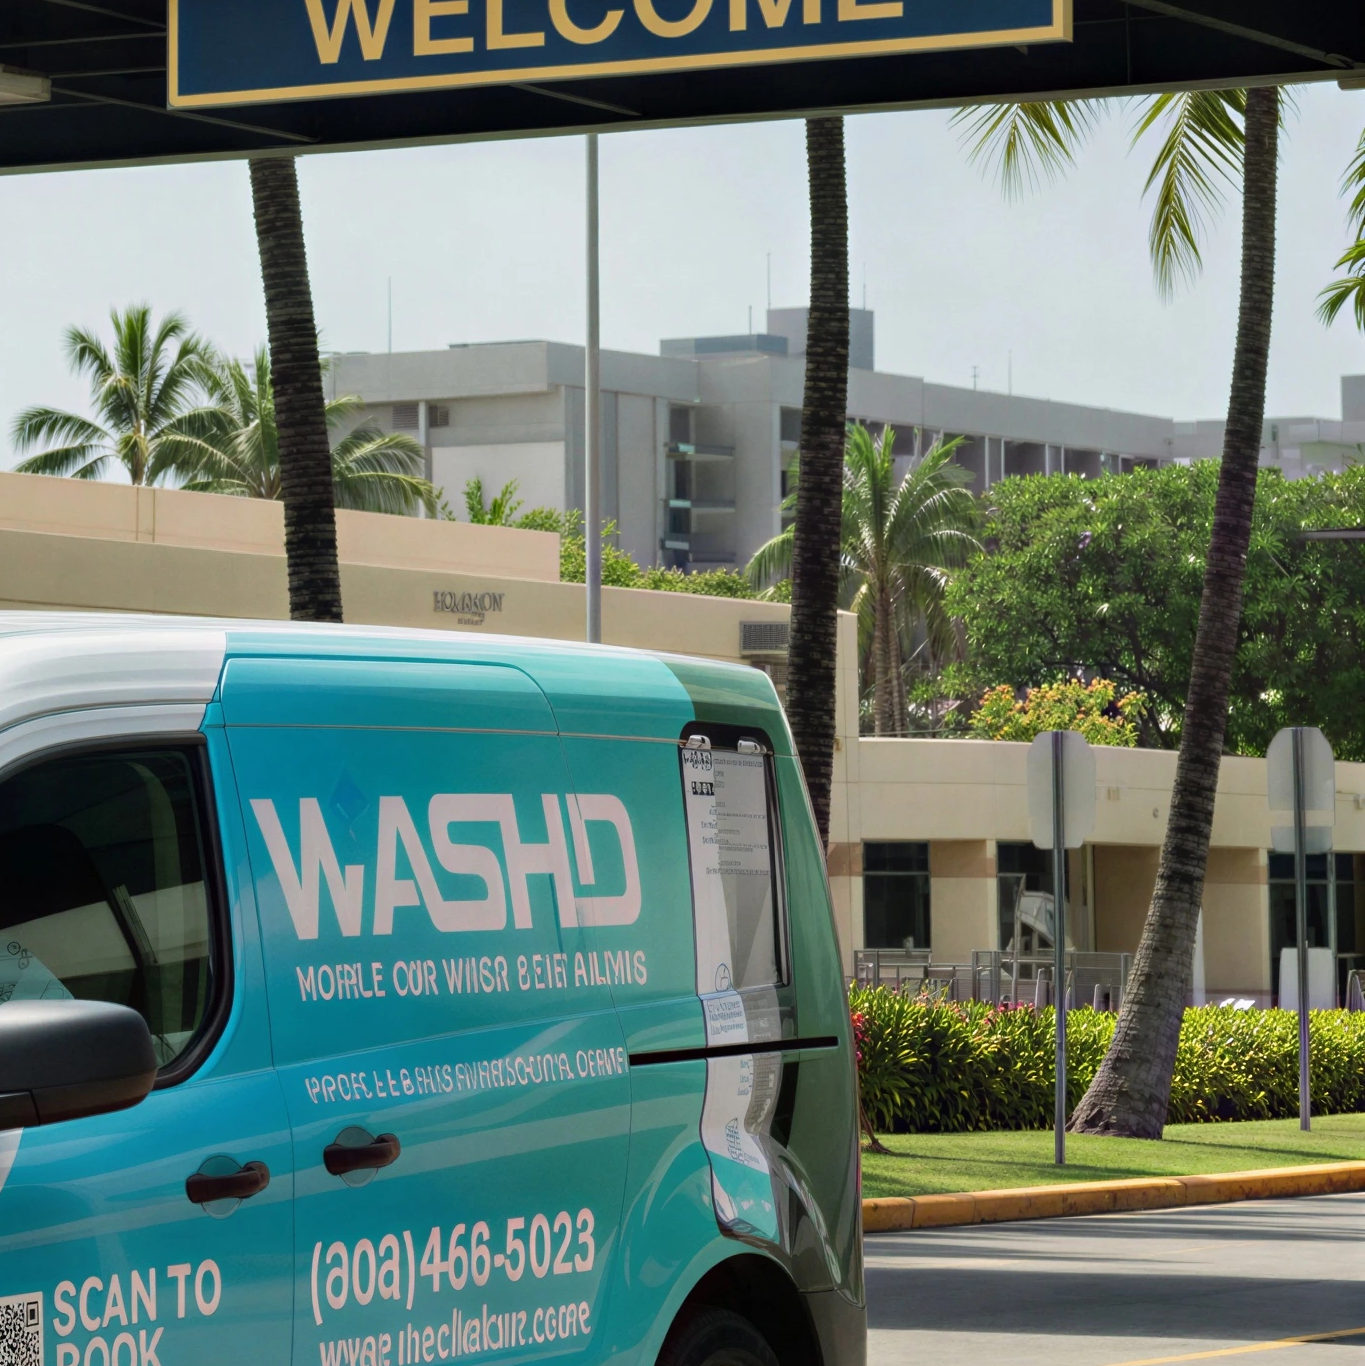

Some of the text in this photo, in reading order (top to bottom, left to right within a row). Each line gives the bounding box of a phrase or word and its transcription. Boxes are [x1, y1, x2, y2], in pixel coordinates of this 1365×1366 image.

[249, 793, 642, 940] WASHD
[53, 1259, 222, 1337] SCAN TO
